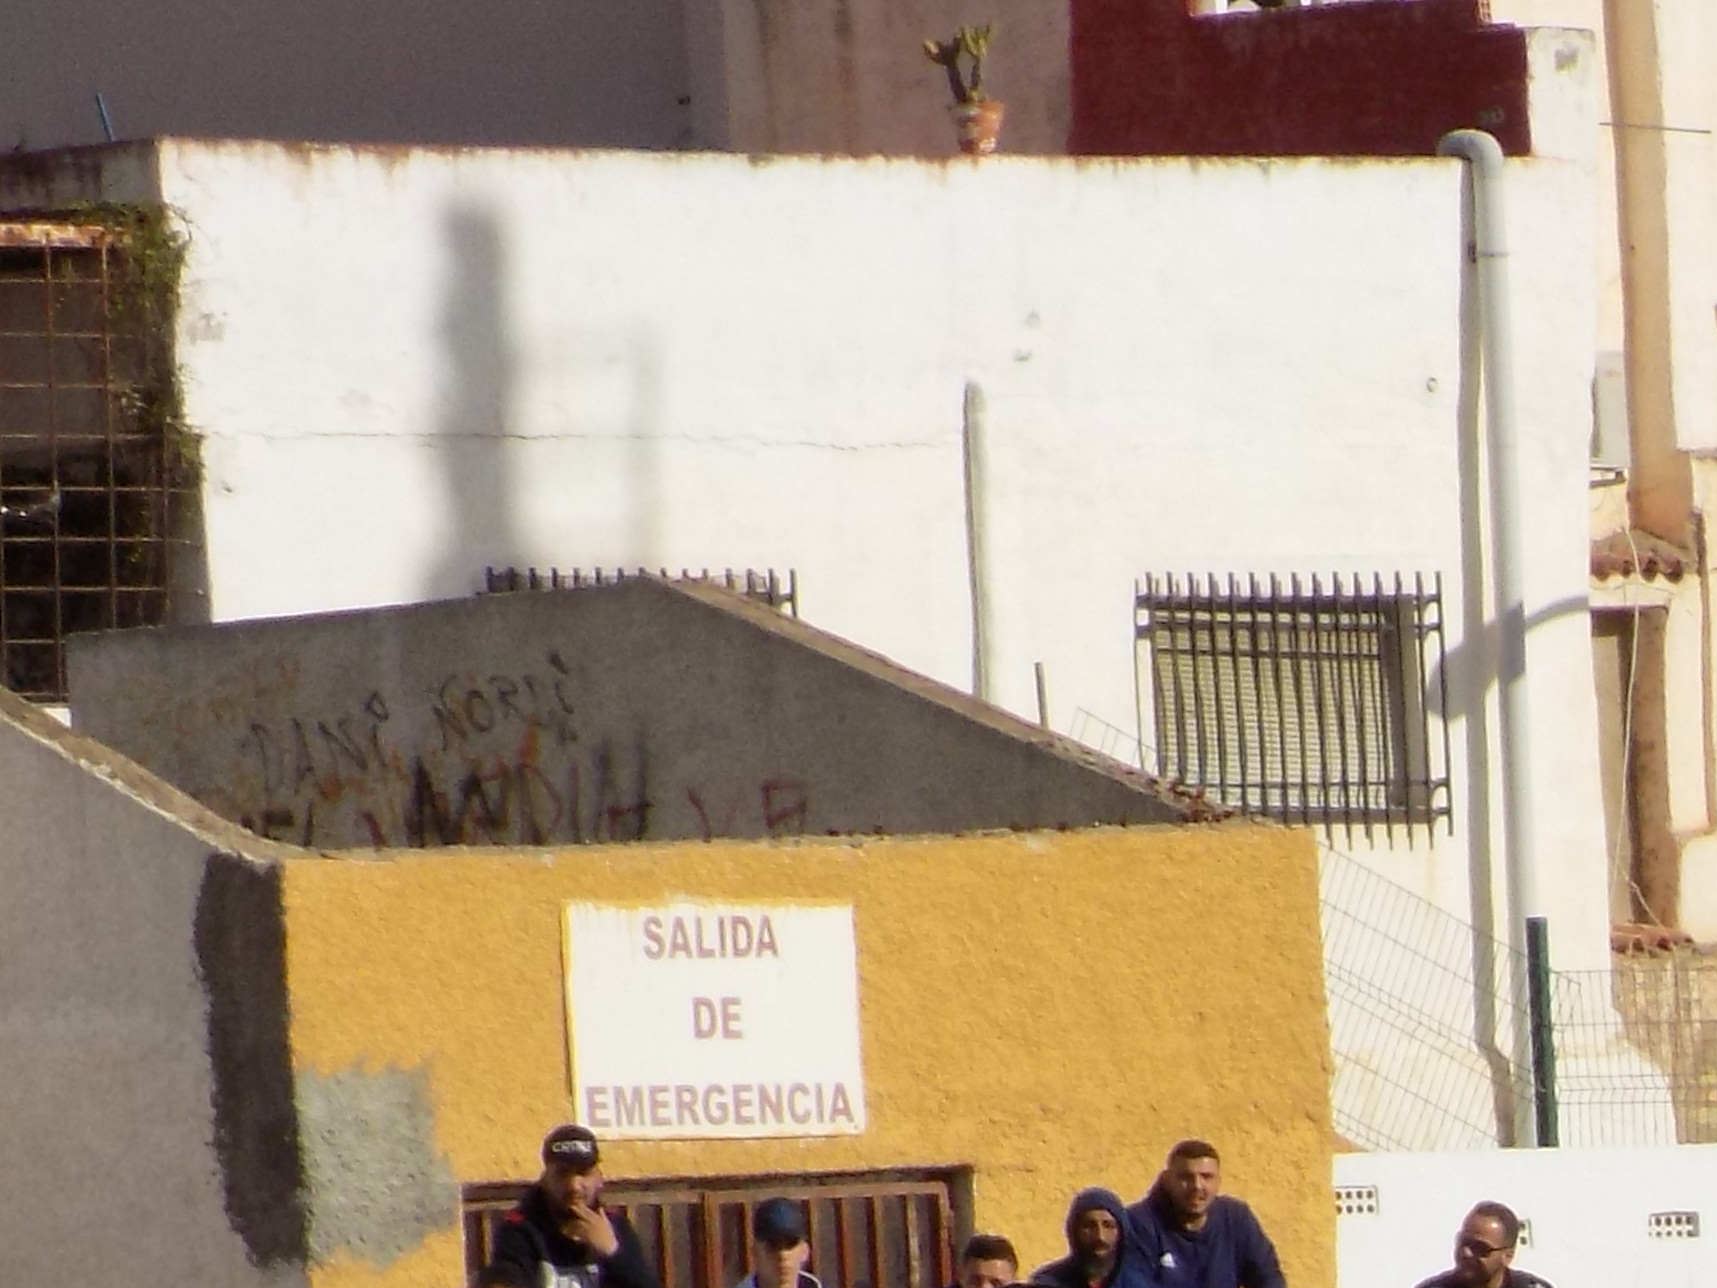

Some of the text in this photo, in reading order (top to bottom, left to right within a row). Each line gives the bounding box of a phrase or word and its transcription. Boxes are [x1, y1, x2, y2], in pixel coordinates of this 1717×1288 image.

[642, 915, 780, 961] SALIDA
[692, 998, 743, 1039] DE
[585, 1082, 855, 1128] EMERGENCIA
